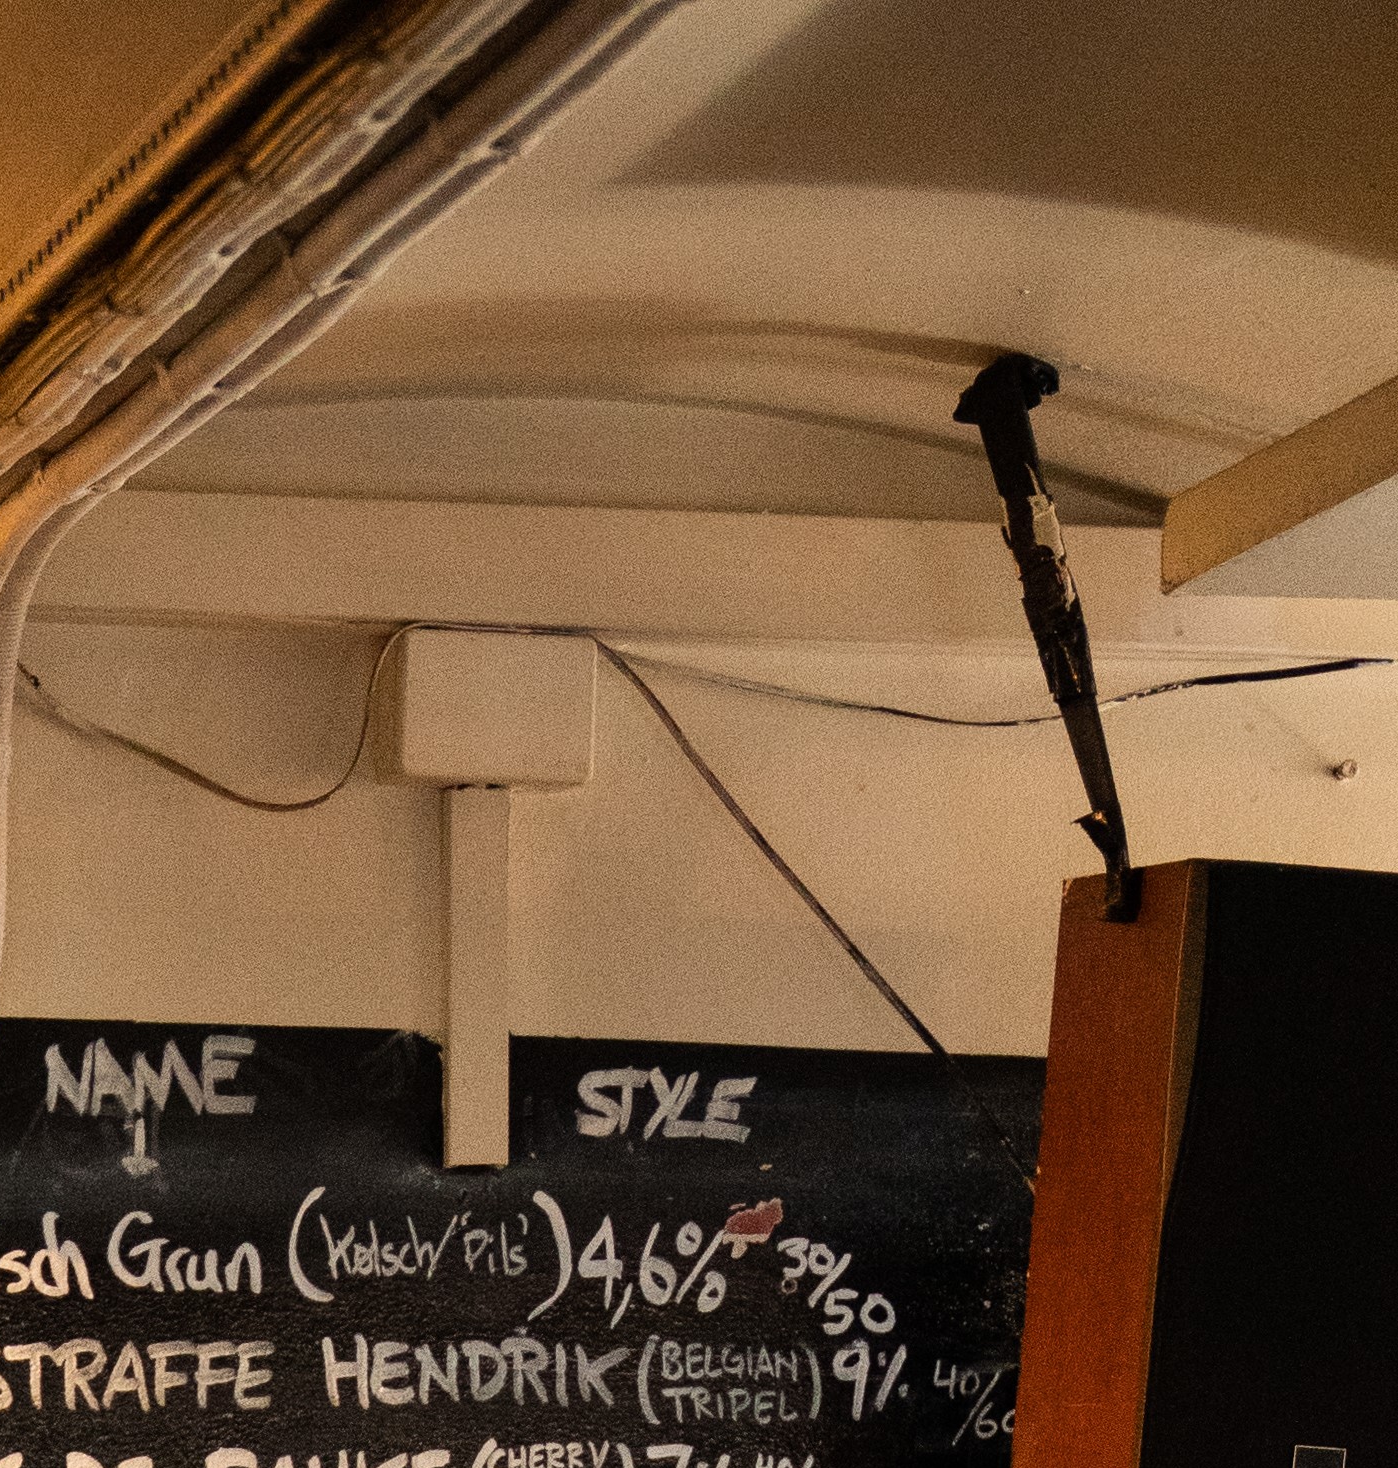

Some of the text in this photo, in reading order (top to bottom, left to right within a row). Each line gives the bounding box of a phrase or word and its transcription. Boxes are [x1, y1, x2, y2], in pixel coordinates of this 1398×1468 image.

[45, 1035, 255, 1117] NAME
[575, 1065, 758, 1143] STYLE
[322, 1334, 630, 1411] HENDRIK
[662, 1341, 798, 1382] BELGIAN
[663, 1387, 803, 1423] TRIPEL
